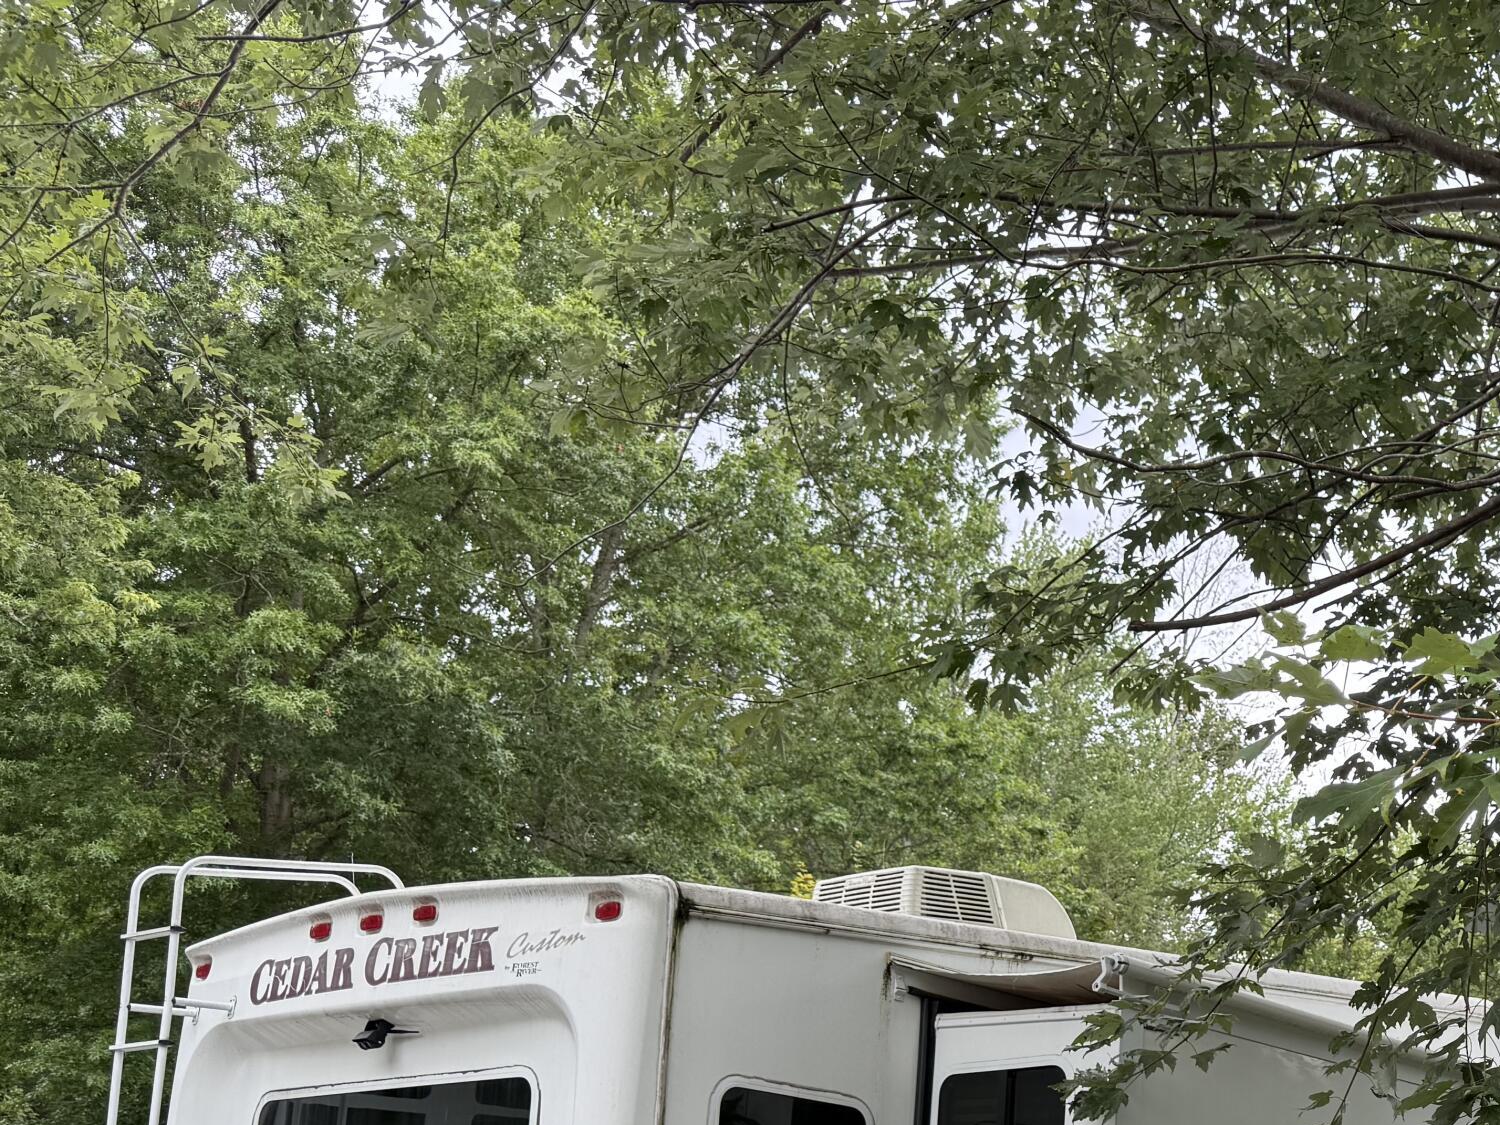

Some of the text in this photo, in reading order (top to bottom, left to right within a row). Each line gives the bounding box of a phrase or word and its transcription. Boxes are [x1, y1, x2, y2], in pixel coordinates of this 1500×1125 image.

[250, 927, 498, 1005] CEDAR CREEK
[506, 928, 586, 959] Custom
